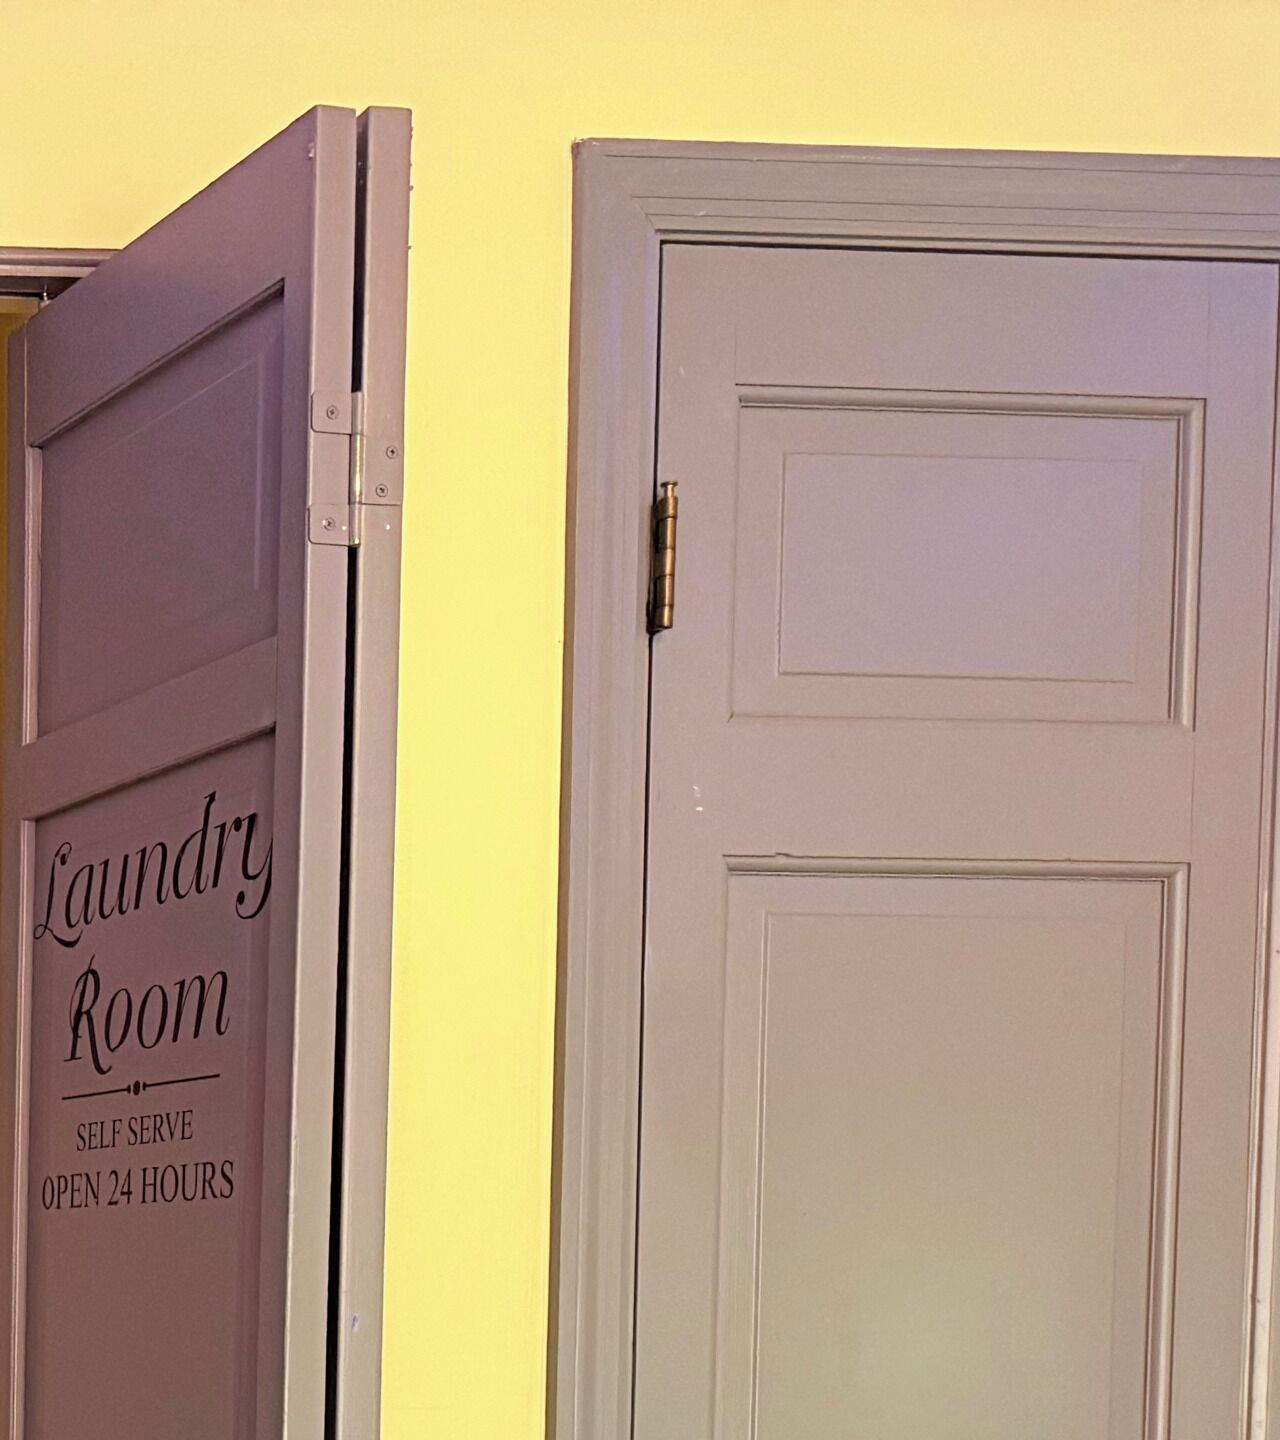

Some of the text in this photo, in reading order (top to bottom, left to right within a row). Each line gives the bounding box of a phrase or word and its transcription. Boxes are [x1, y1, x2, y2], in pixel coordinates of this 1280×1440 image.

[33, 791, 273, 948] Laundry
[64, 953, 230, 1075] Room
[76, 1110, 194, 1152] SELF SERVE
[42, 1160, 235, 1211] OPEN 24 HOURS
